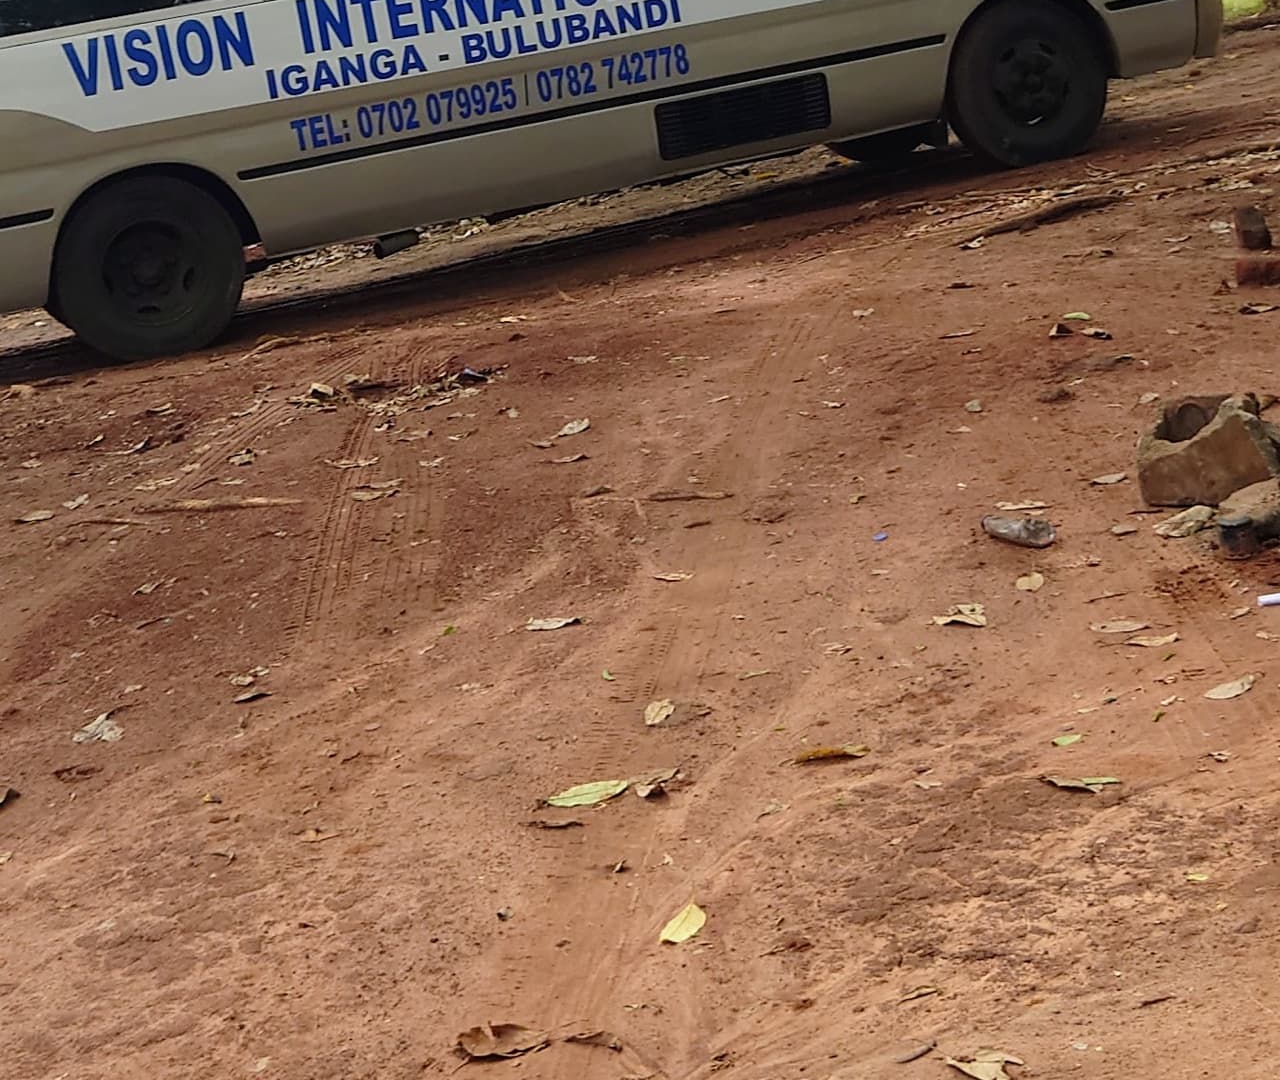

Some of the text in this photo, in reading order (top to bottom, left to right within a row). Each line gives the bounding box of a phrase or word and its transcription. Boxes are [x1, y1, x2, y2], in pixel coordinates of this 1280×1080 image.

[62, 12, 255, 97] VISION
[266, 40, 426, 99] IGANGA
[290, 114, 352, 152] TEL:
[356, 98, 420, 139] 0702
[426, 78, 518, 127] 079925
[536, 61, 598, 104] 0782
[601, 43, 690, 90] 742778
